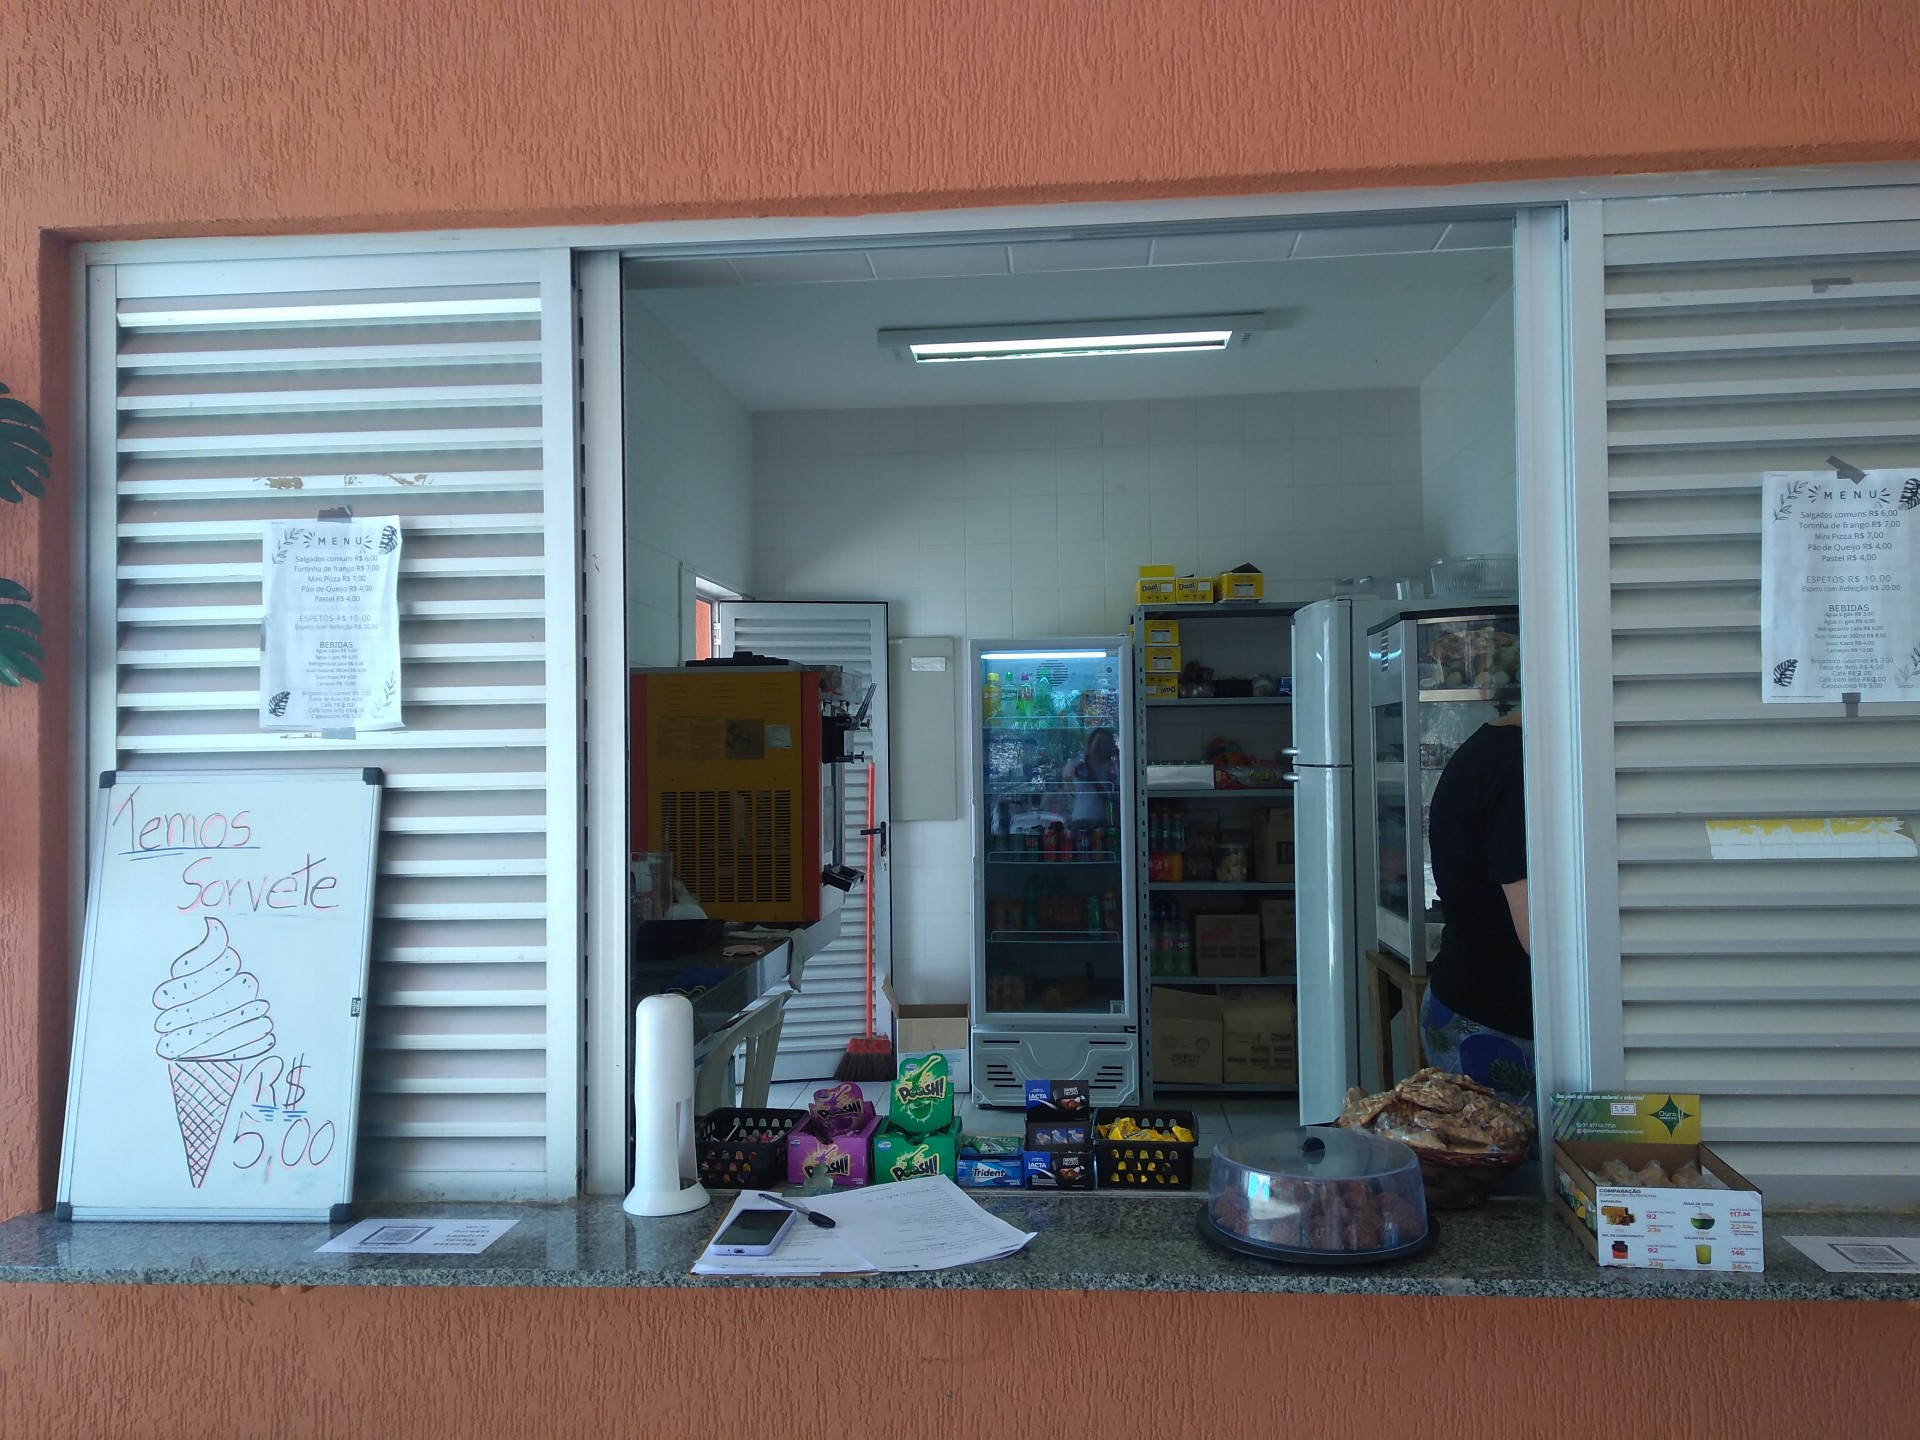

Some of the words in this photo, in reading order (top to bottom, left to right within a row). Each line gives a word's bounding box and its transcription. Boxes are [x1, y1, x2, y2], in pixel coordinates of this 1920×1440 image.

[1824, 491, 1877, 499] MENU
[1801, 511, 1832, 519] Salgados
[1842, 521, 1870, 530] frango
[1834, 544, 1860, 552] Queijo
[1806, 575, 1845, 583] ESPETOS
[112, 786, 251, 851] Temos
[177, 853, 338, 912] Sorvete
[243, 1053, 311, 1110] R$
[973, 1168, 1005, 1177] Trident
